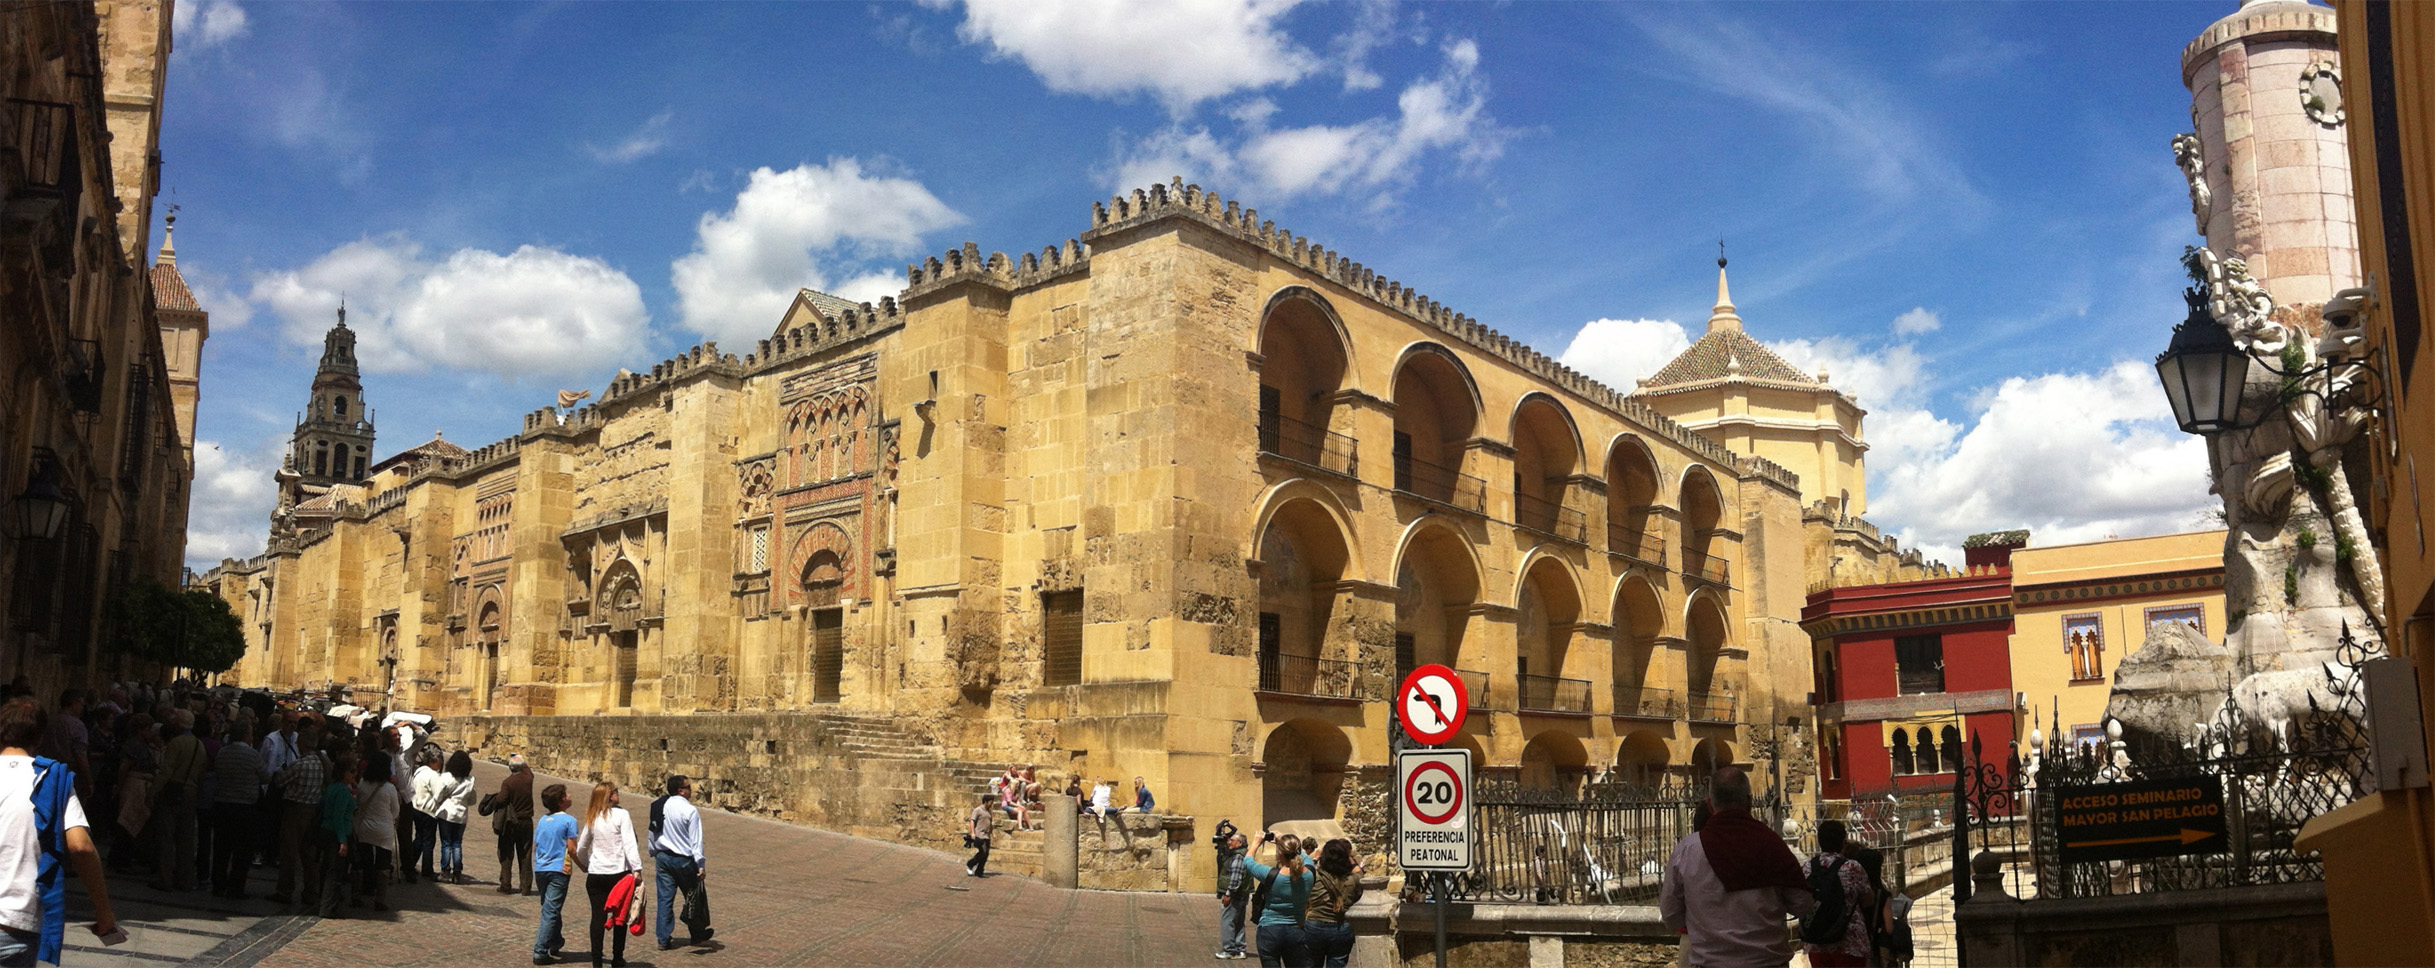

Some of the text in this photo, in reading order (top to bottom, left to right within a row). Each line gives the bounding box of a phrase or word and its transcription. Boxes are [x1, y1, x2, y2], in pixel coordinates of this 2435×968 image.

[1417, 781, 1452, 804] 20
[2062, 787, 2202, 810] ACCESO SEMINARIO
[2063, 804, 2218, 827] MAYOR SAN PELAGIO
[1405, 831, 1464, 843] PREFERENCIA
[1410, 849, 1458, 861] PEATONAL
